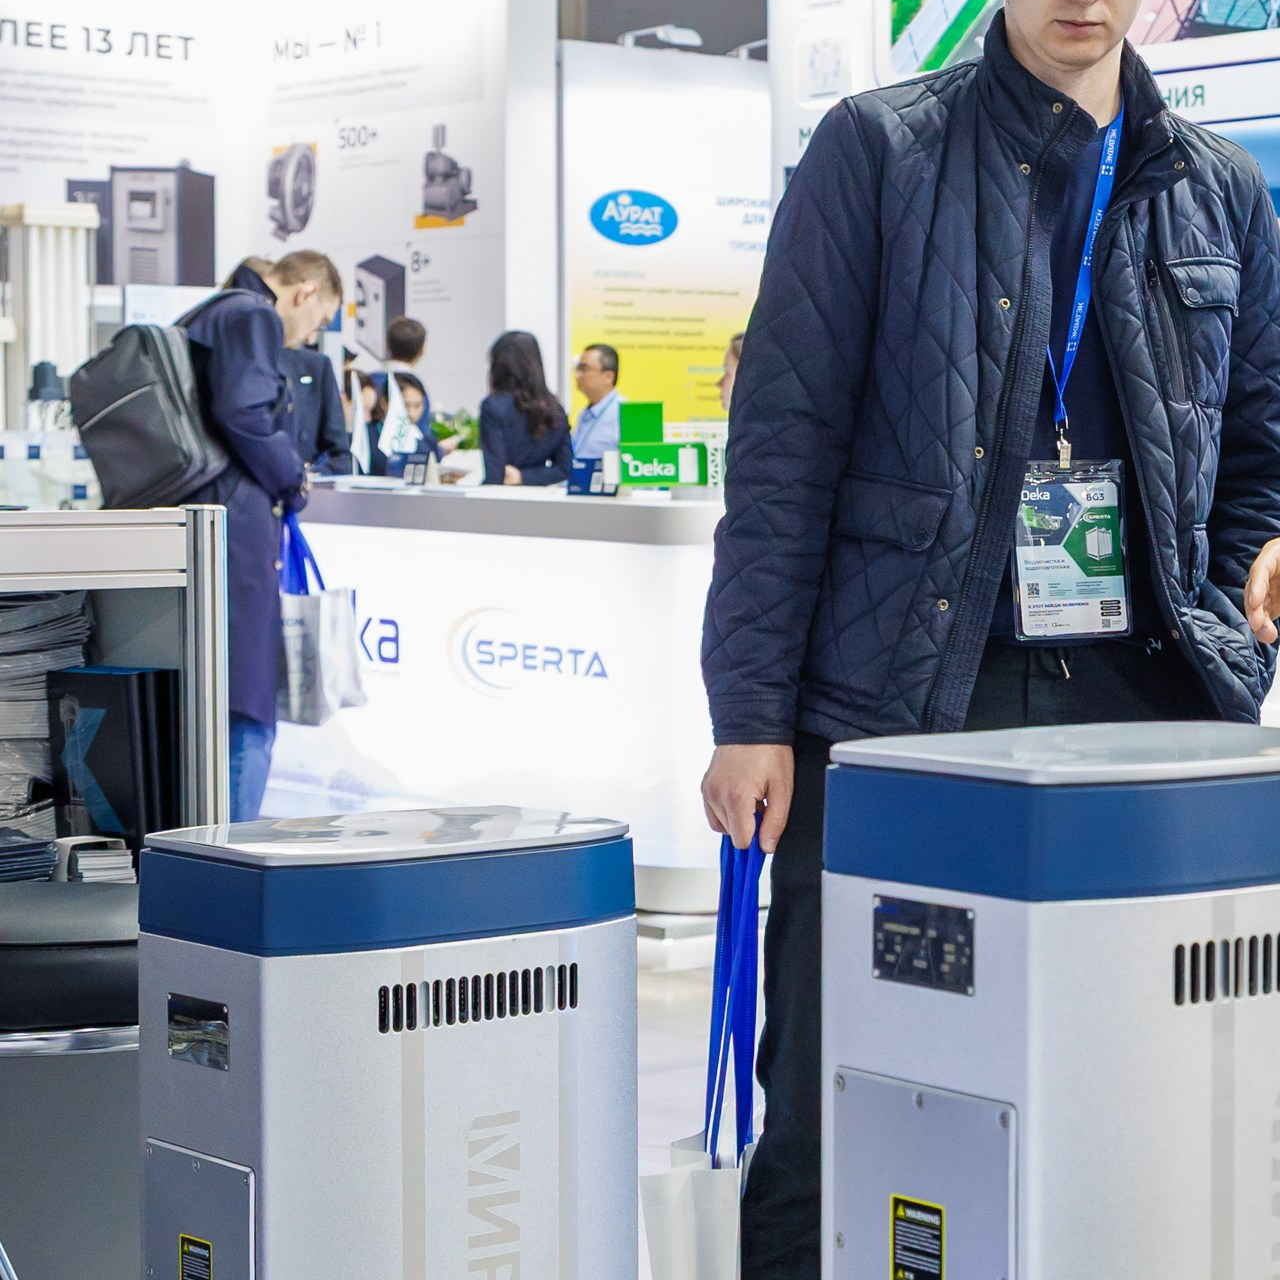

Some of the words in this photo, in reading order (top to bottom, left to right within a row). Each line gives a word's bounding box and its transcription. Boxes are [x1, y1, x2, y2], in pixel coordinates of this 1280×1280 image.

[82, 27, 112, 54] 13
[127, 32, 195, 61] ЛЕТ
[339, 126, 377, 149] 500+
[628, 458, 676, 477] Deka
[1021, 488, 1050, 501] Deka
[476, 640, 609, 679] SPERTA
